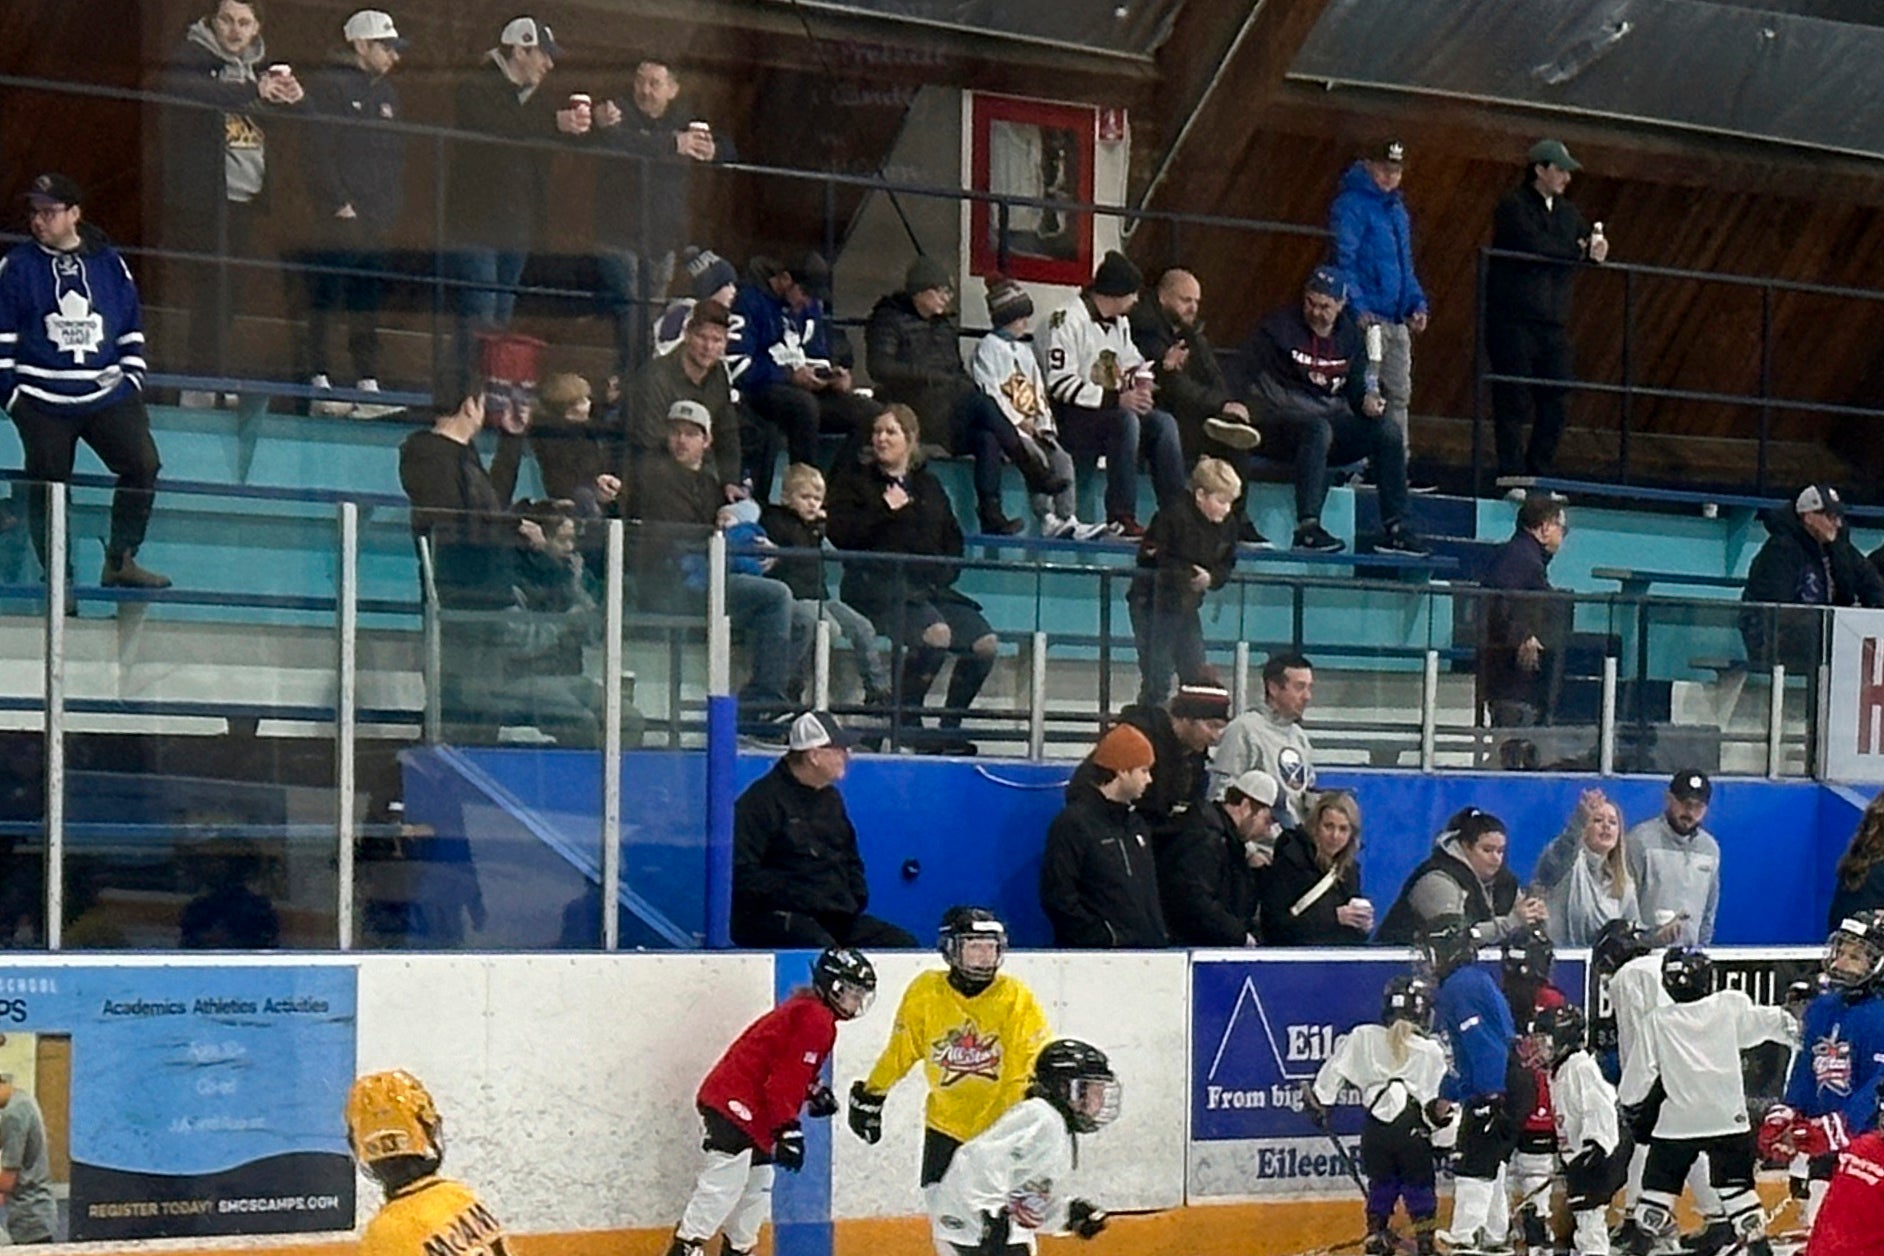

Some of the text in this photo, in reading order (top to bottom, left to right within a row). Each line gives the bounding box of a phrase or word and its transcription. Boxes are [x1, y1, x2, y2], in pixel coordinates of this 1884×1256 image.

[103, 995, 330, 1016] Academics Athletics Activities
[1207, 1084, 1266, 1110] From
[1271, 1084, 1304, 1112] big
[88, 1202, 159, 1219] REGISTER
